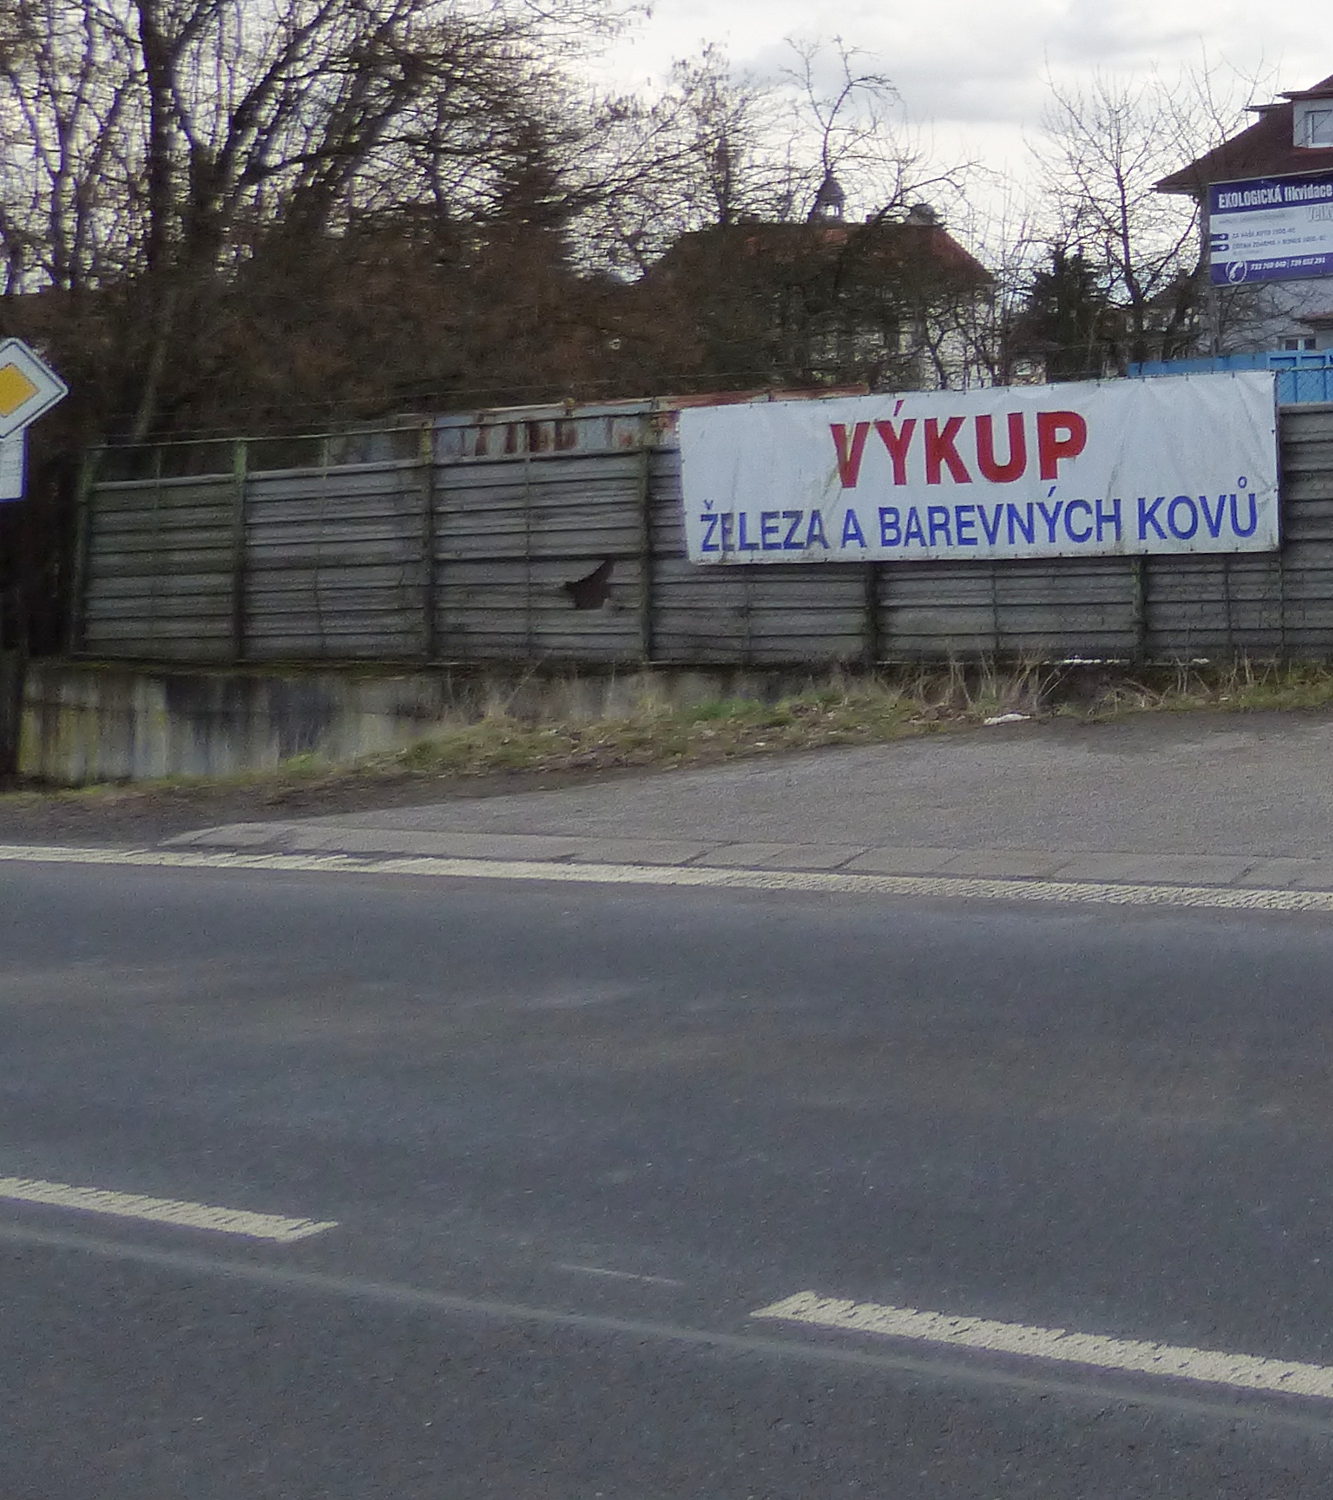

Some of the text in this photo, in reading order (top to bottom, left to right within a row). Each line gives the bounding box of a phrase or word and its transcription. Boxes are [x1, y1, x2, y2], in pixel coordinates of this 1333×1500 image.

[1218, 184, 1283, 209] EKOLOGICKÁ
[1284, 183, 1333, 202] likvidace
[830, 399, 1088, 488] VÝKUP
[700, 475, 1258, 552] ŽELEZA A BAREVNÝCH KOVŮ
